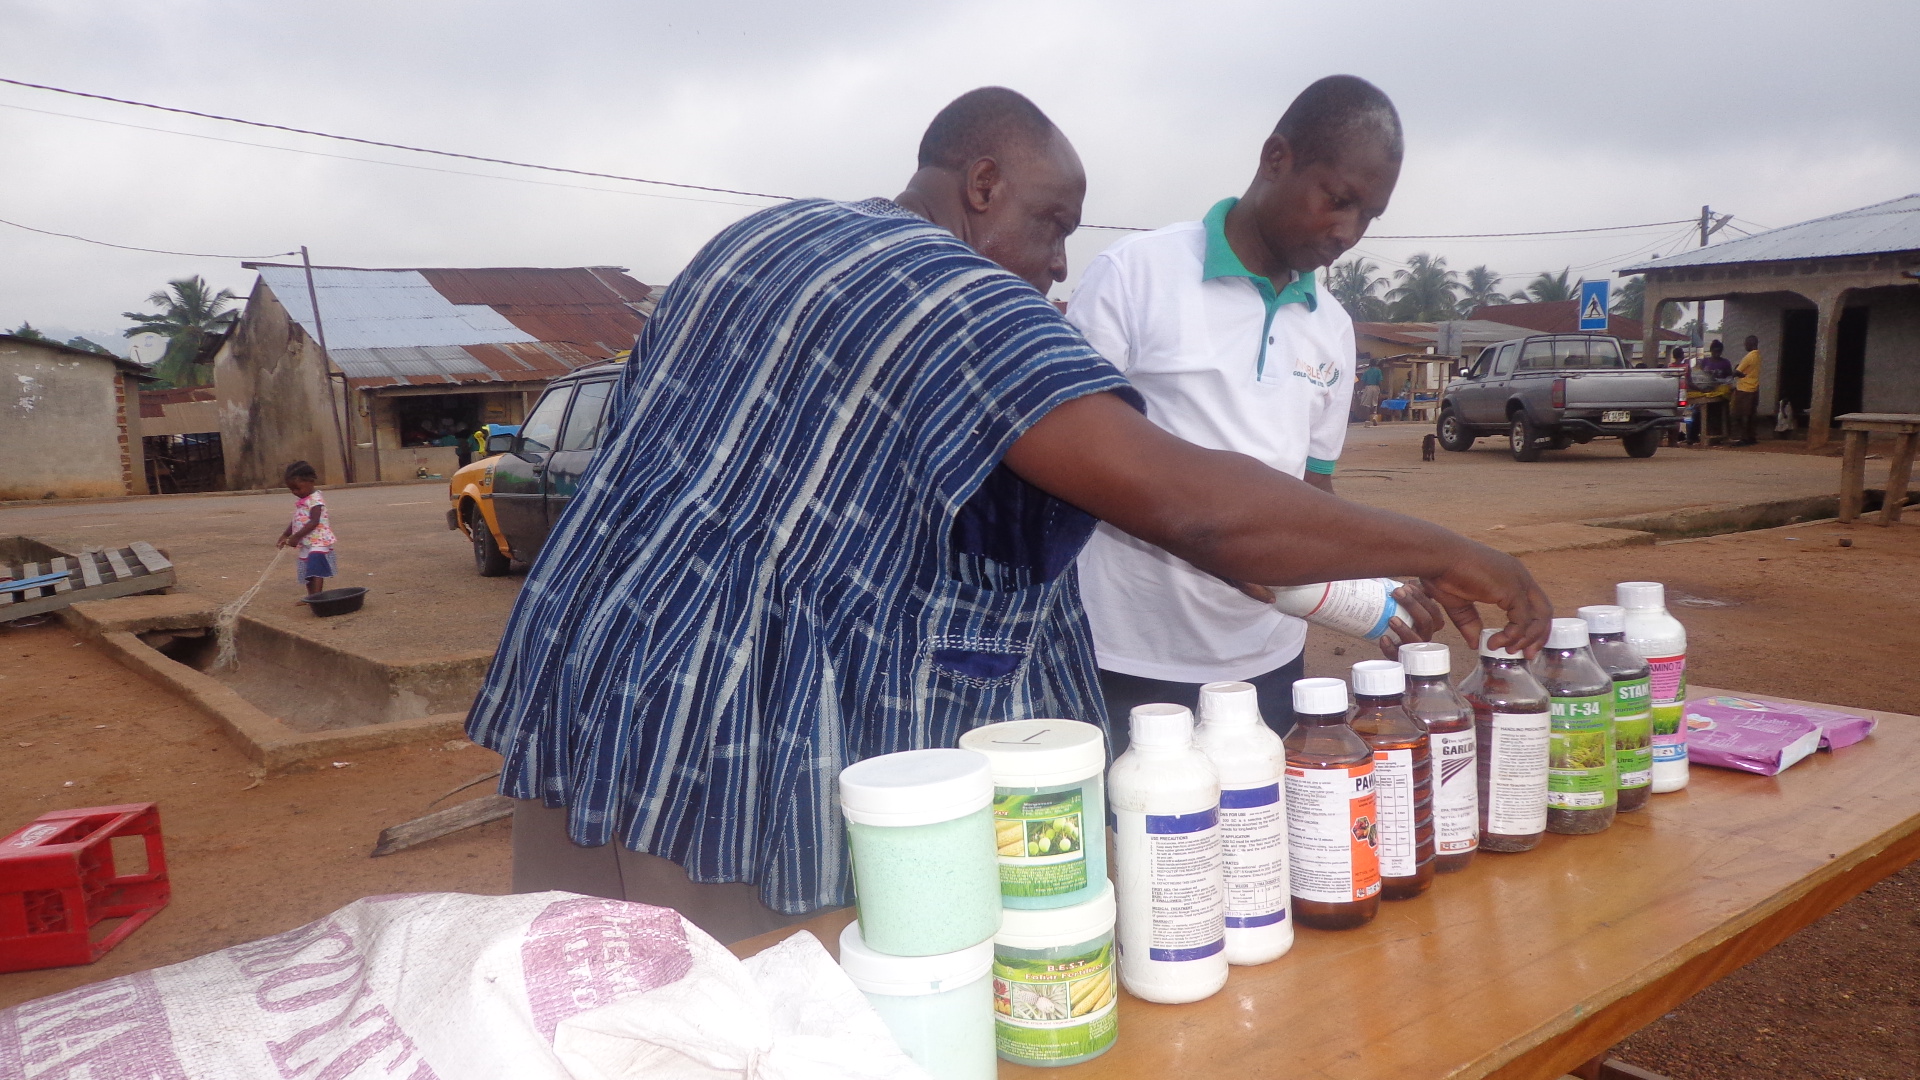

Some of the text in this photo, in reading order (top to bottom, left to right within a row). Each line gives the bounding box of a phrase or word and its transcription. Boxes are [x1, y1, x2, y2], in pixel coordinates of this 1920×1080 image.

[1570, 701, 1600, 717] F-34
[1025, 962, 1104, 981] Foliar Fertilizer
